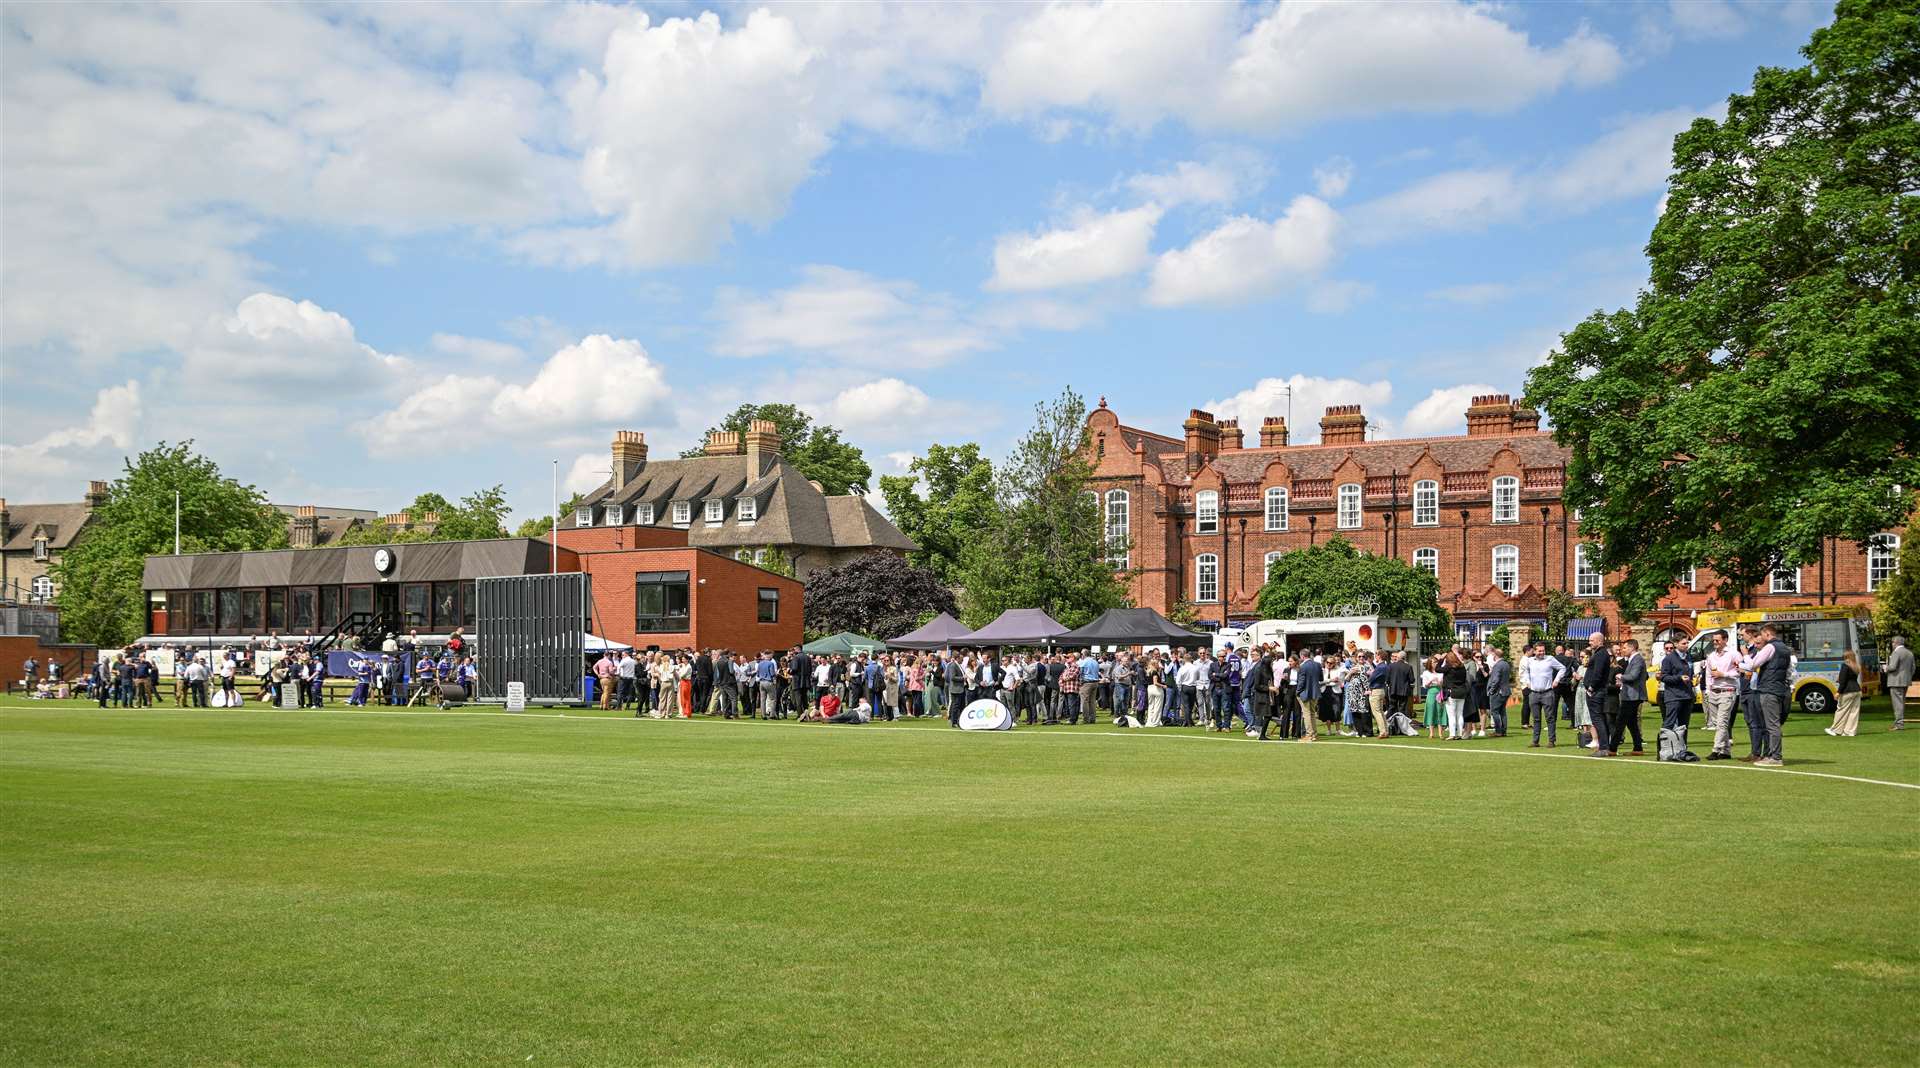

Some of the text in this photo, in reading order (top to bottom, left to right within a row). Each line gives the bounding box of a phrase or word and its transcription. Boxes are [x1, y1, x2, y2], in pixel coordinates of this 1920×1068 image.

[1766, 611, 1817, 620] TONI'S ICES
[967, 703, 998, 719] coel
